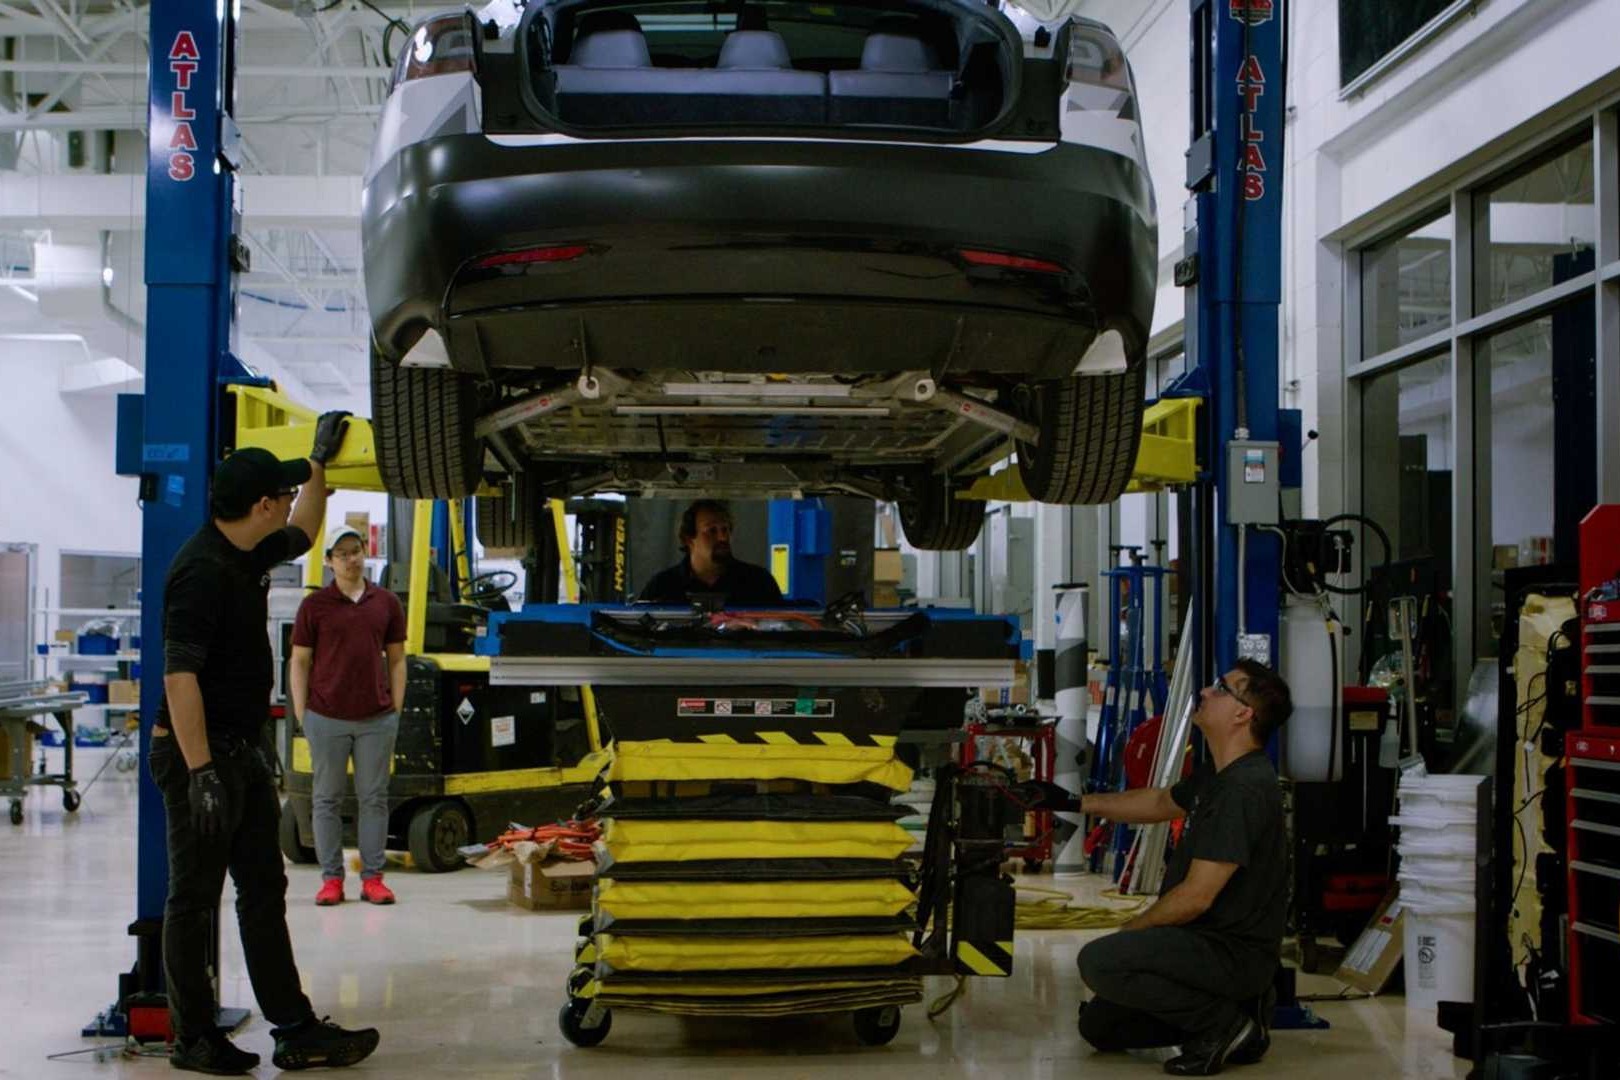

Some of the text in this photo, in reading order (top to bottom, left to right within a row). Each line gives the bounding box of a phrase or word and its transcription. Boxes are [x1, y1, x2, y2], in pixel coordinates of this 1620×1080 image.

[168, 30, 200, 182] ATLAS
[1235, 55, 1267, 201] ATLAS
[614, 516, 625, 592] HYSTER
